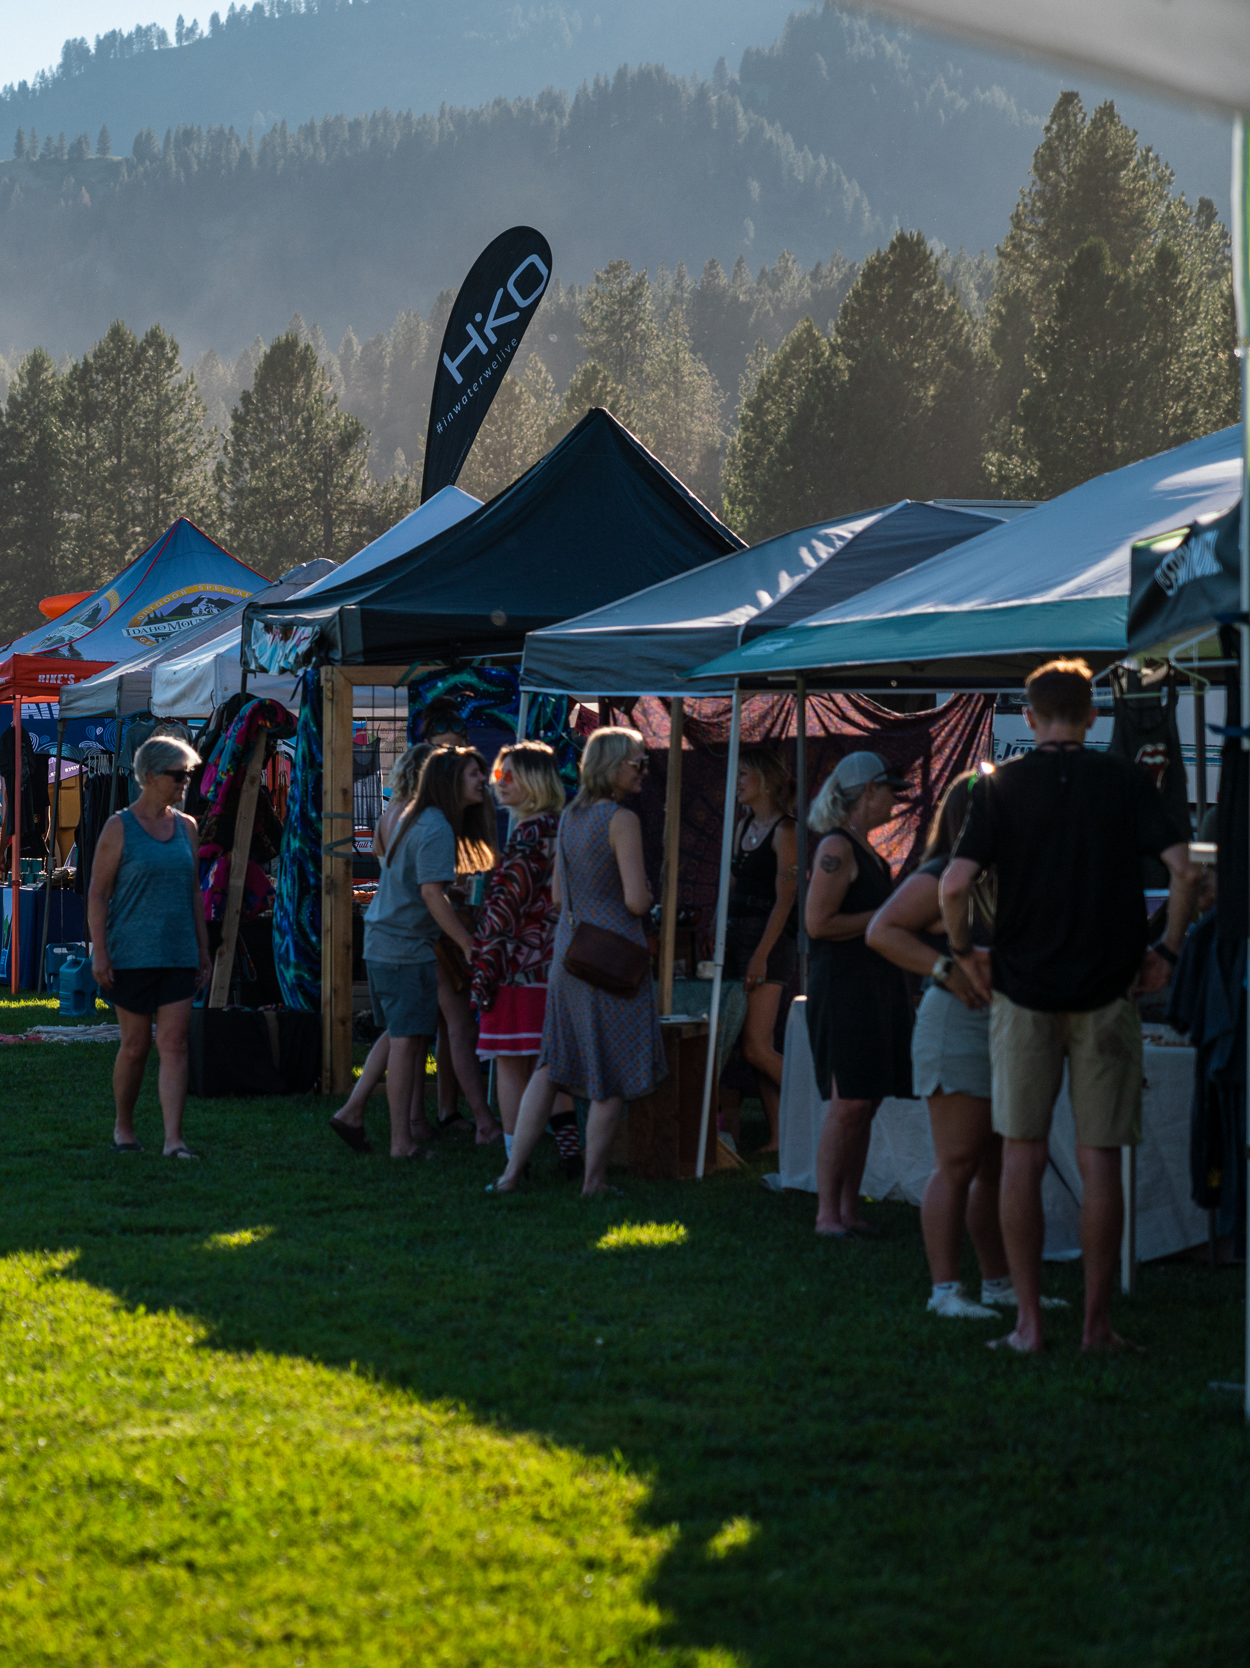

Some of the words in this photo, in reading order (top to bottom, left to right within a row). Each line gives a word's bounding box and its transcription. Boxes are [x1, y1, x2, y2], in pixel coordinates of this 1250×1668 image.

[436, 337, 518, 434] #inwaterwelive
[137, 590, 187, 620] OUTDOOR
[125, 625, 166, 637] IDAHO
